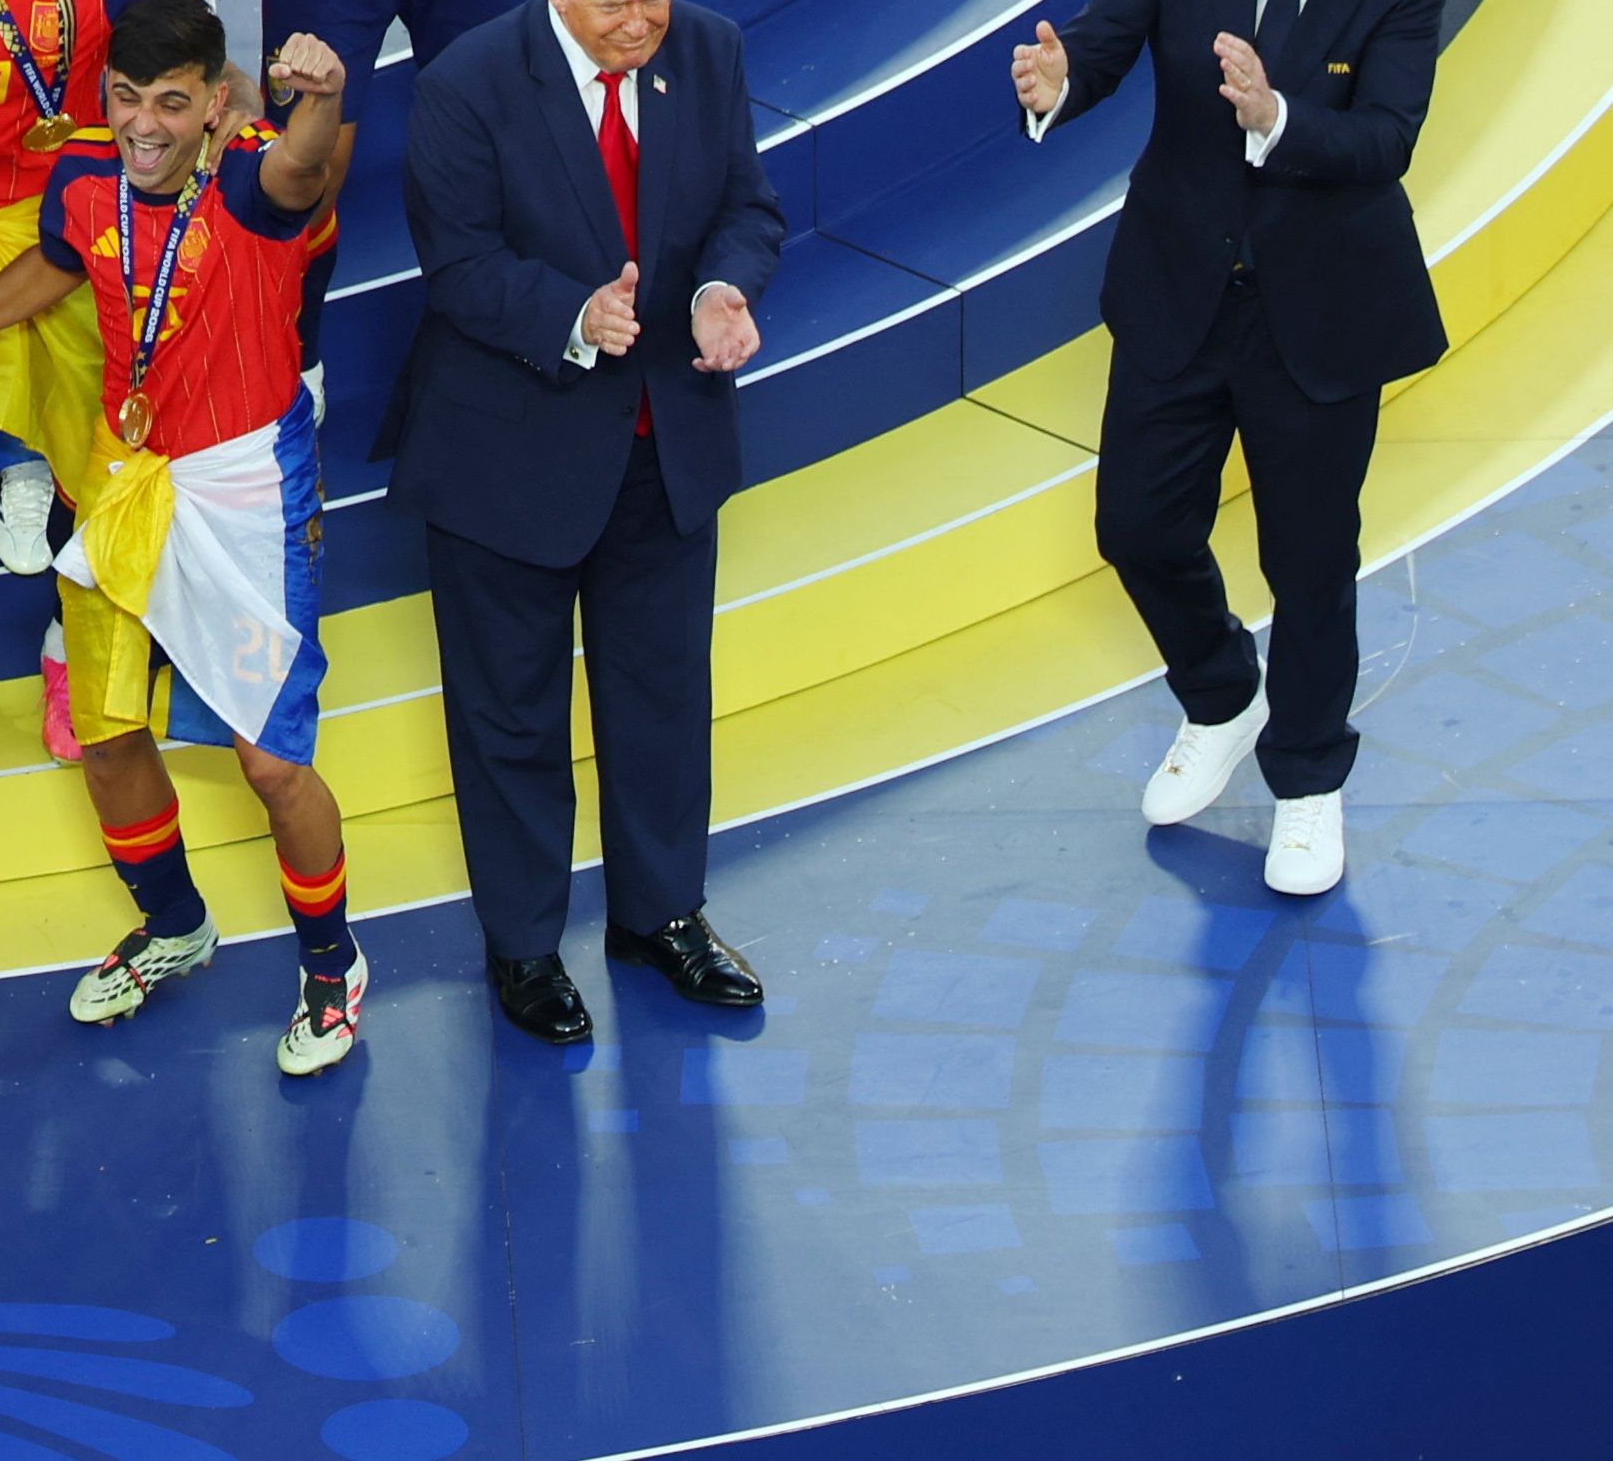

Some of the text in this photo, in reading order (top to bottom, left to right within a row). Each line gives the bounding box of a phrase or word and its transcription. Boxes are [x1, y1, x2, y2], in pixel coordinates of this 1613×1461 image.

[23, 62, 50, 109] FIFA WORLD
[1327, 62, 1351, 75] FIFA
[119, 173, 132, 275] WORLD CUP 2026
[144, 227, 181, 343] FIFA WORLD CUP 2026
